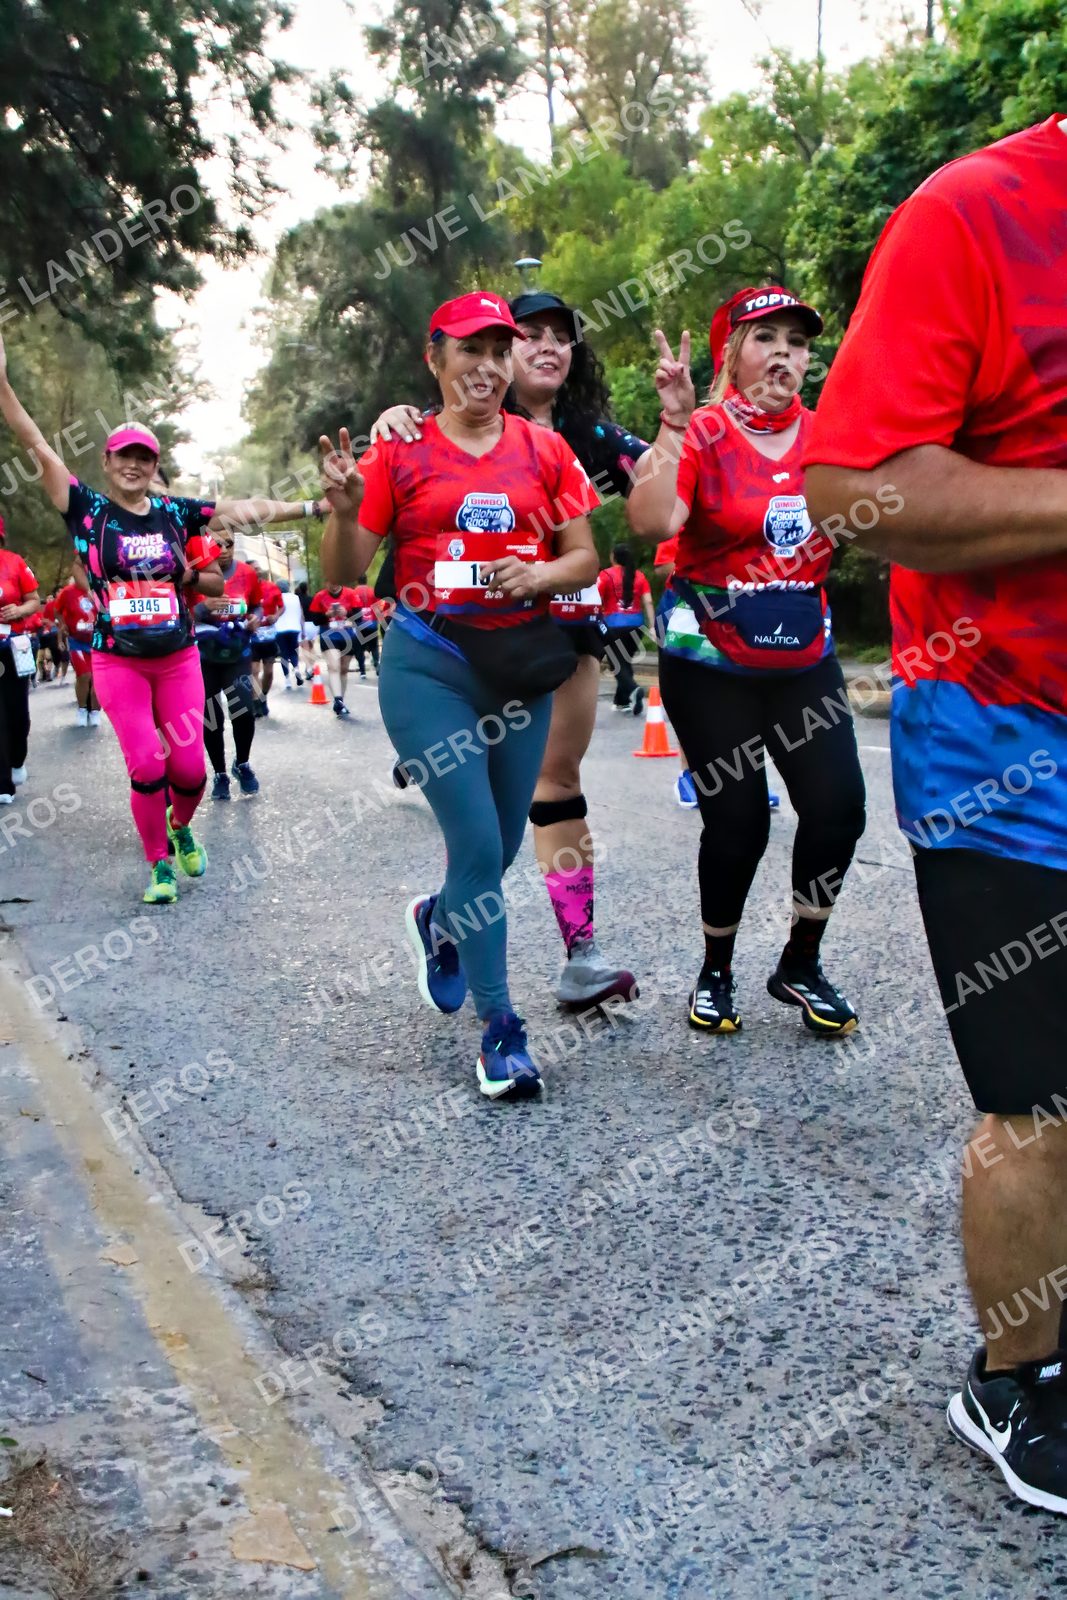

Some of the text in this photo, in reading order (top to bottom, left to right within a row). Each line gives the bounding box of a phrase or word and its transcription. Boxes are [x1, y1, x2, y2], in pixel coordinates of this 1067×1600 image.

[471, 508, 501, 519] Global
[776, 510, 803, 521] Global
[465, 518, 489, 528] Race
[771, 520, 793, 530] Race
[121, 532, 166, 547] POWER
[129, 599, 160, 613] 3345
[754, 634, 800, 646] NAUTICA
[1039, 1362, 1062, 1379] NIKE
